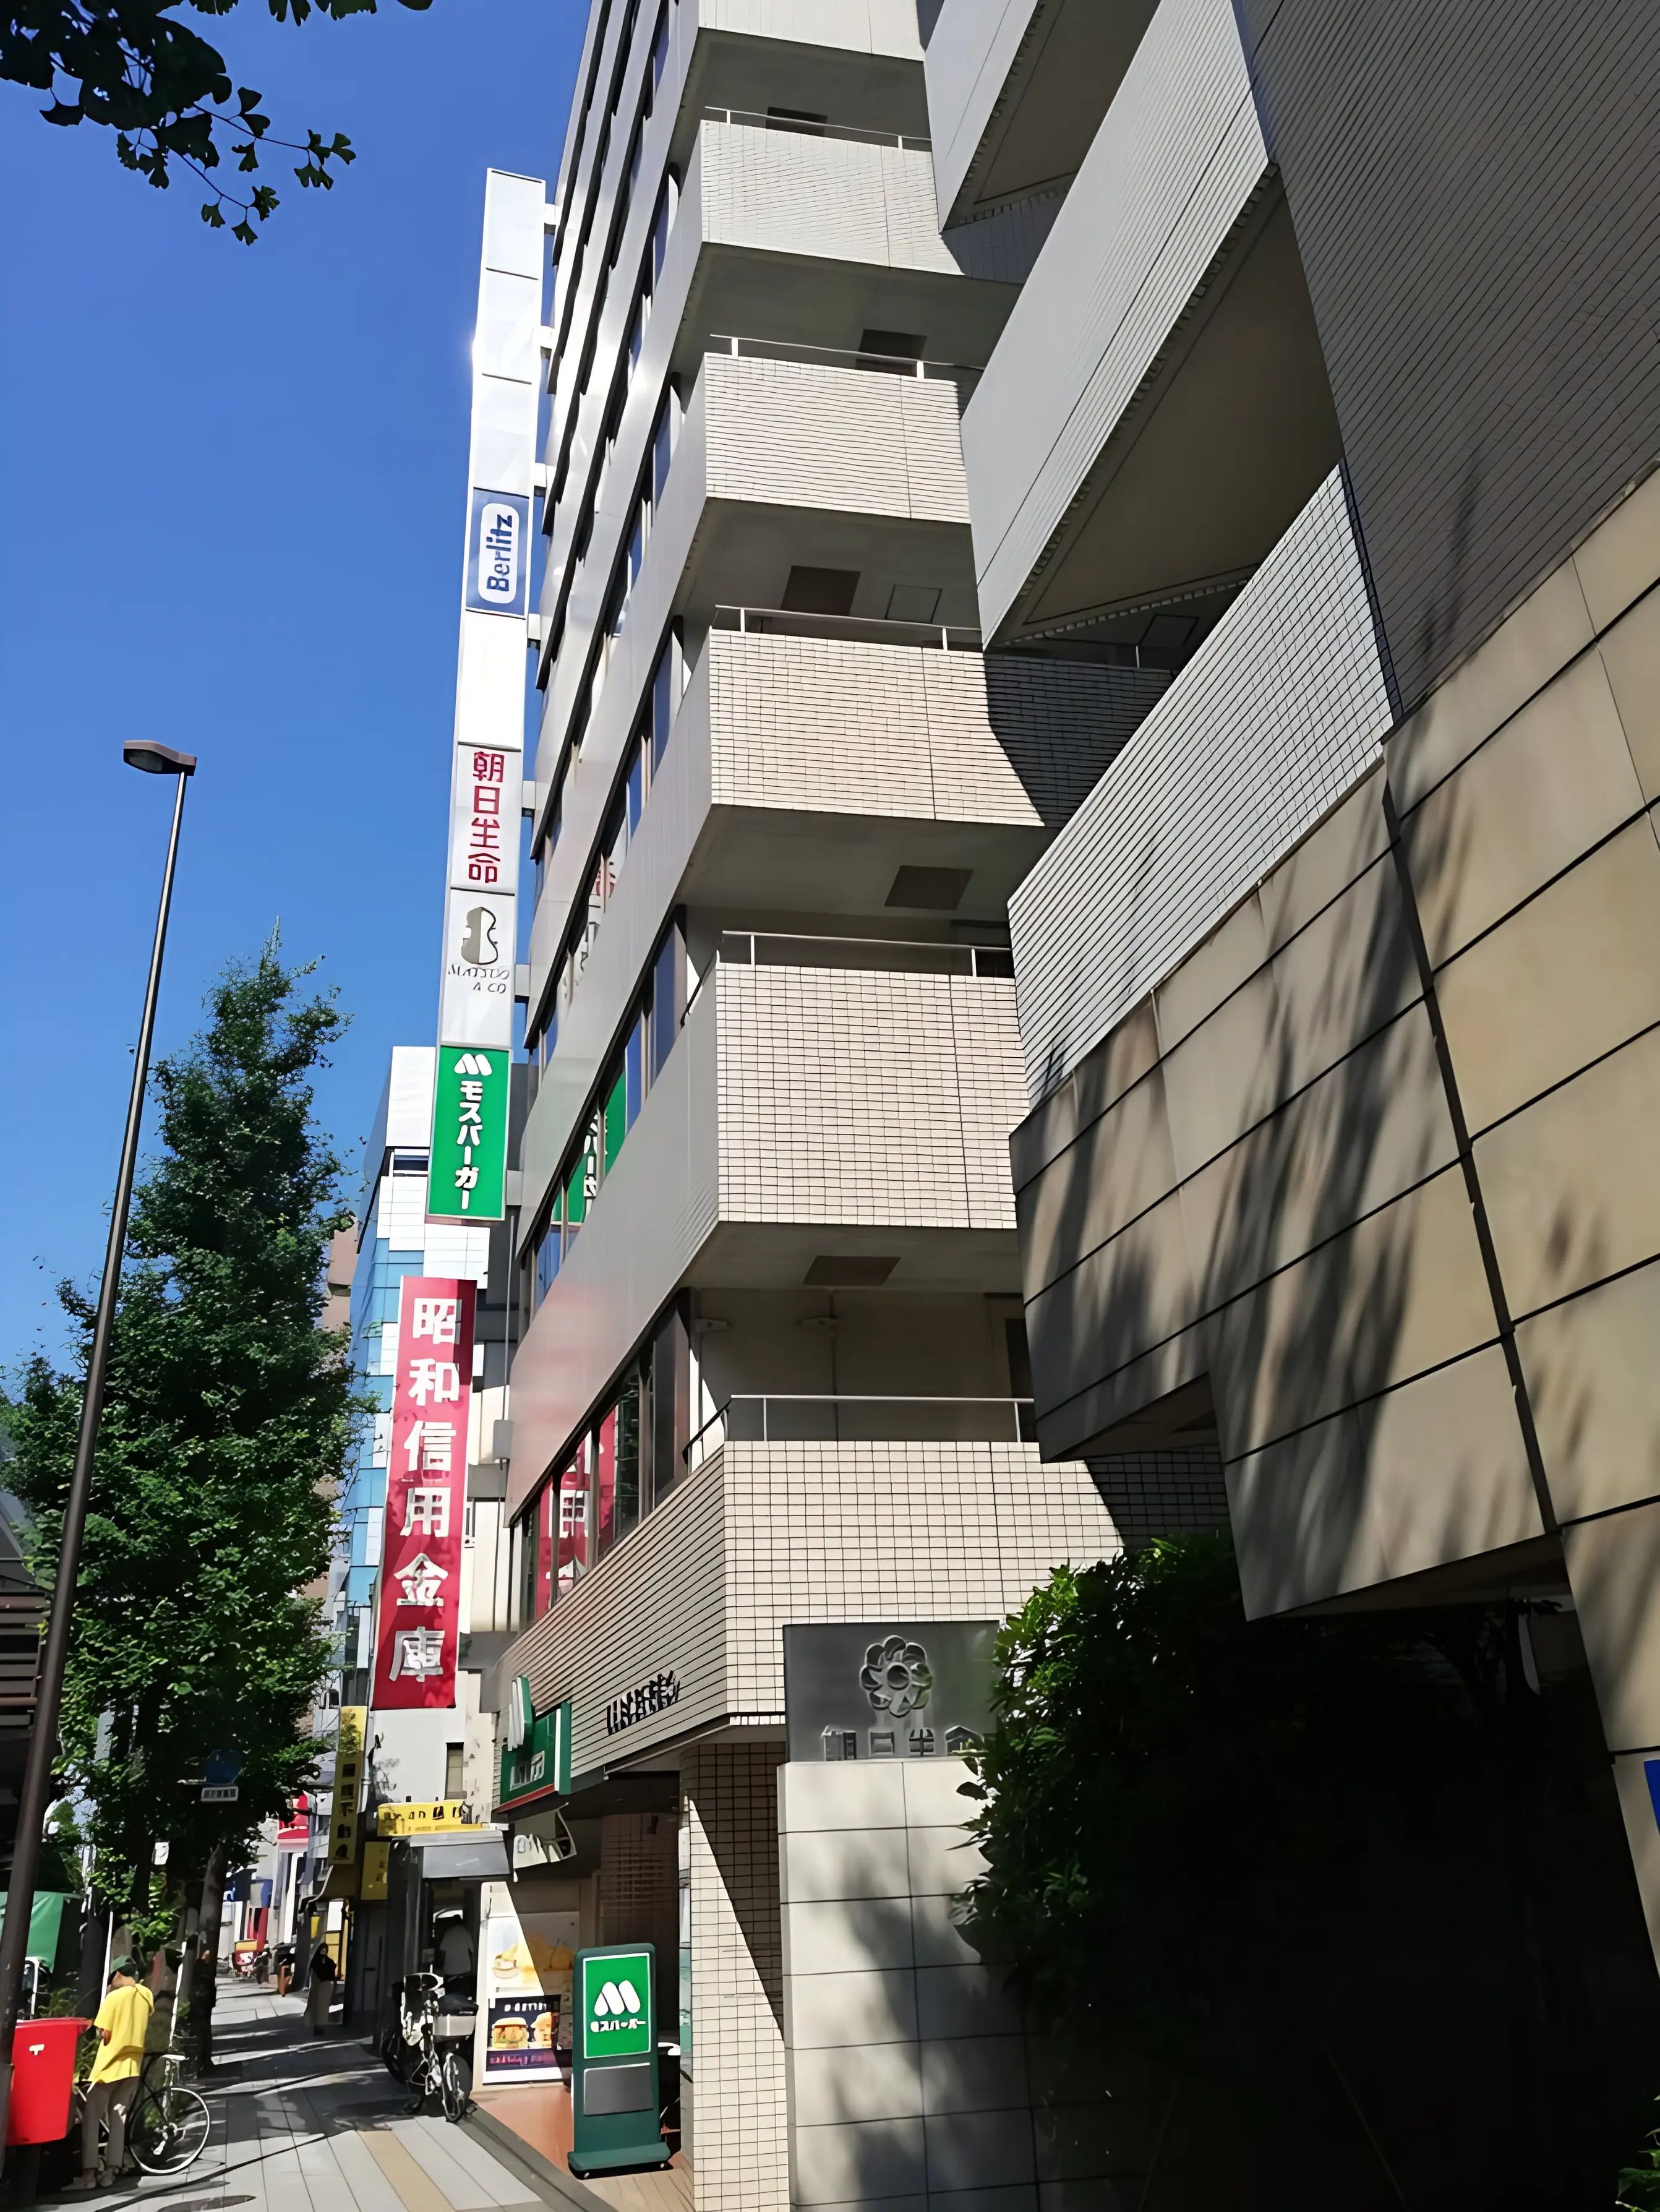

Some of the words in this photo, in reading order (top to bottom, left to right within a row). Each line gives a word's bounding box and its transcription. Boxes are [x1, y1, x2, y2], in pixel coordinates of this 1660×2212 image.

[486, 514, 513, 593] Berlitz
[468, 751, 505, 884] 朝日生命
[455, 1080, 483, 1210] モスバーガー
[389, 1297, 462, 1683] 昭和信用金庫
